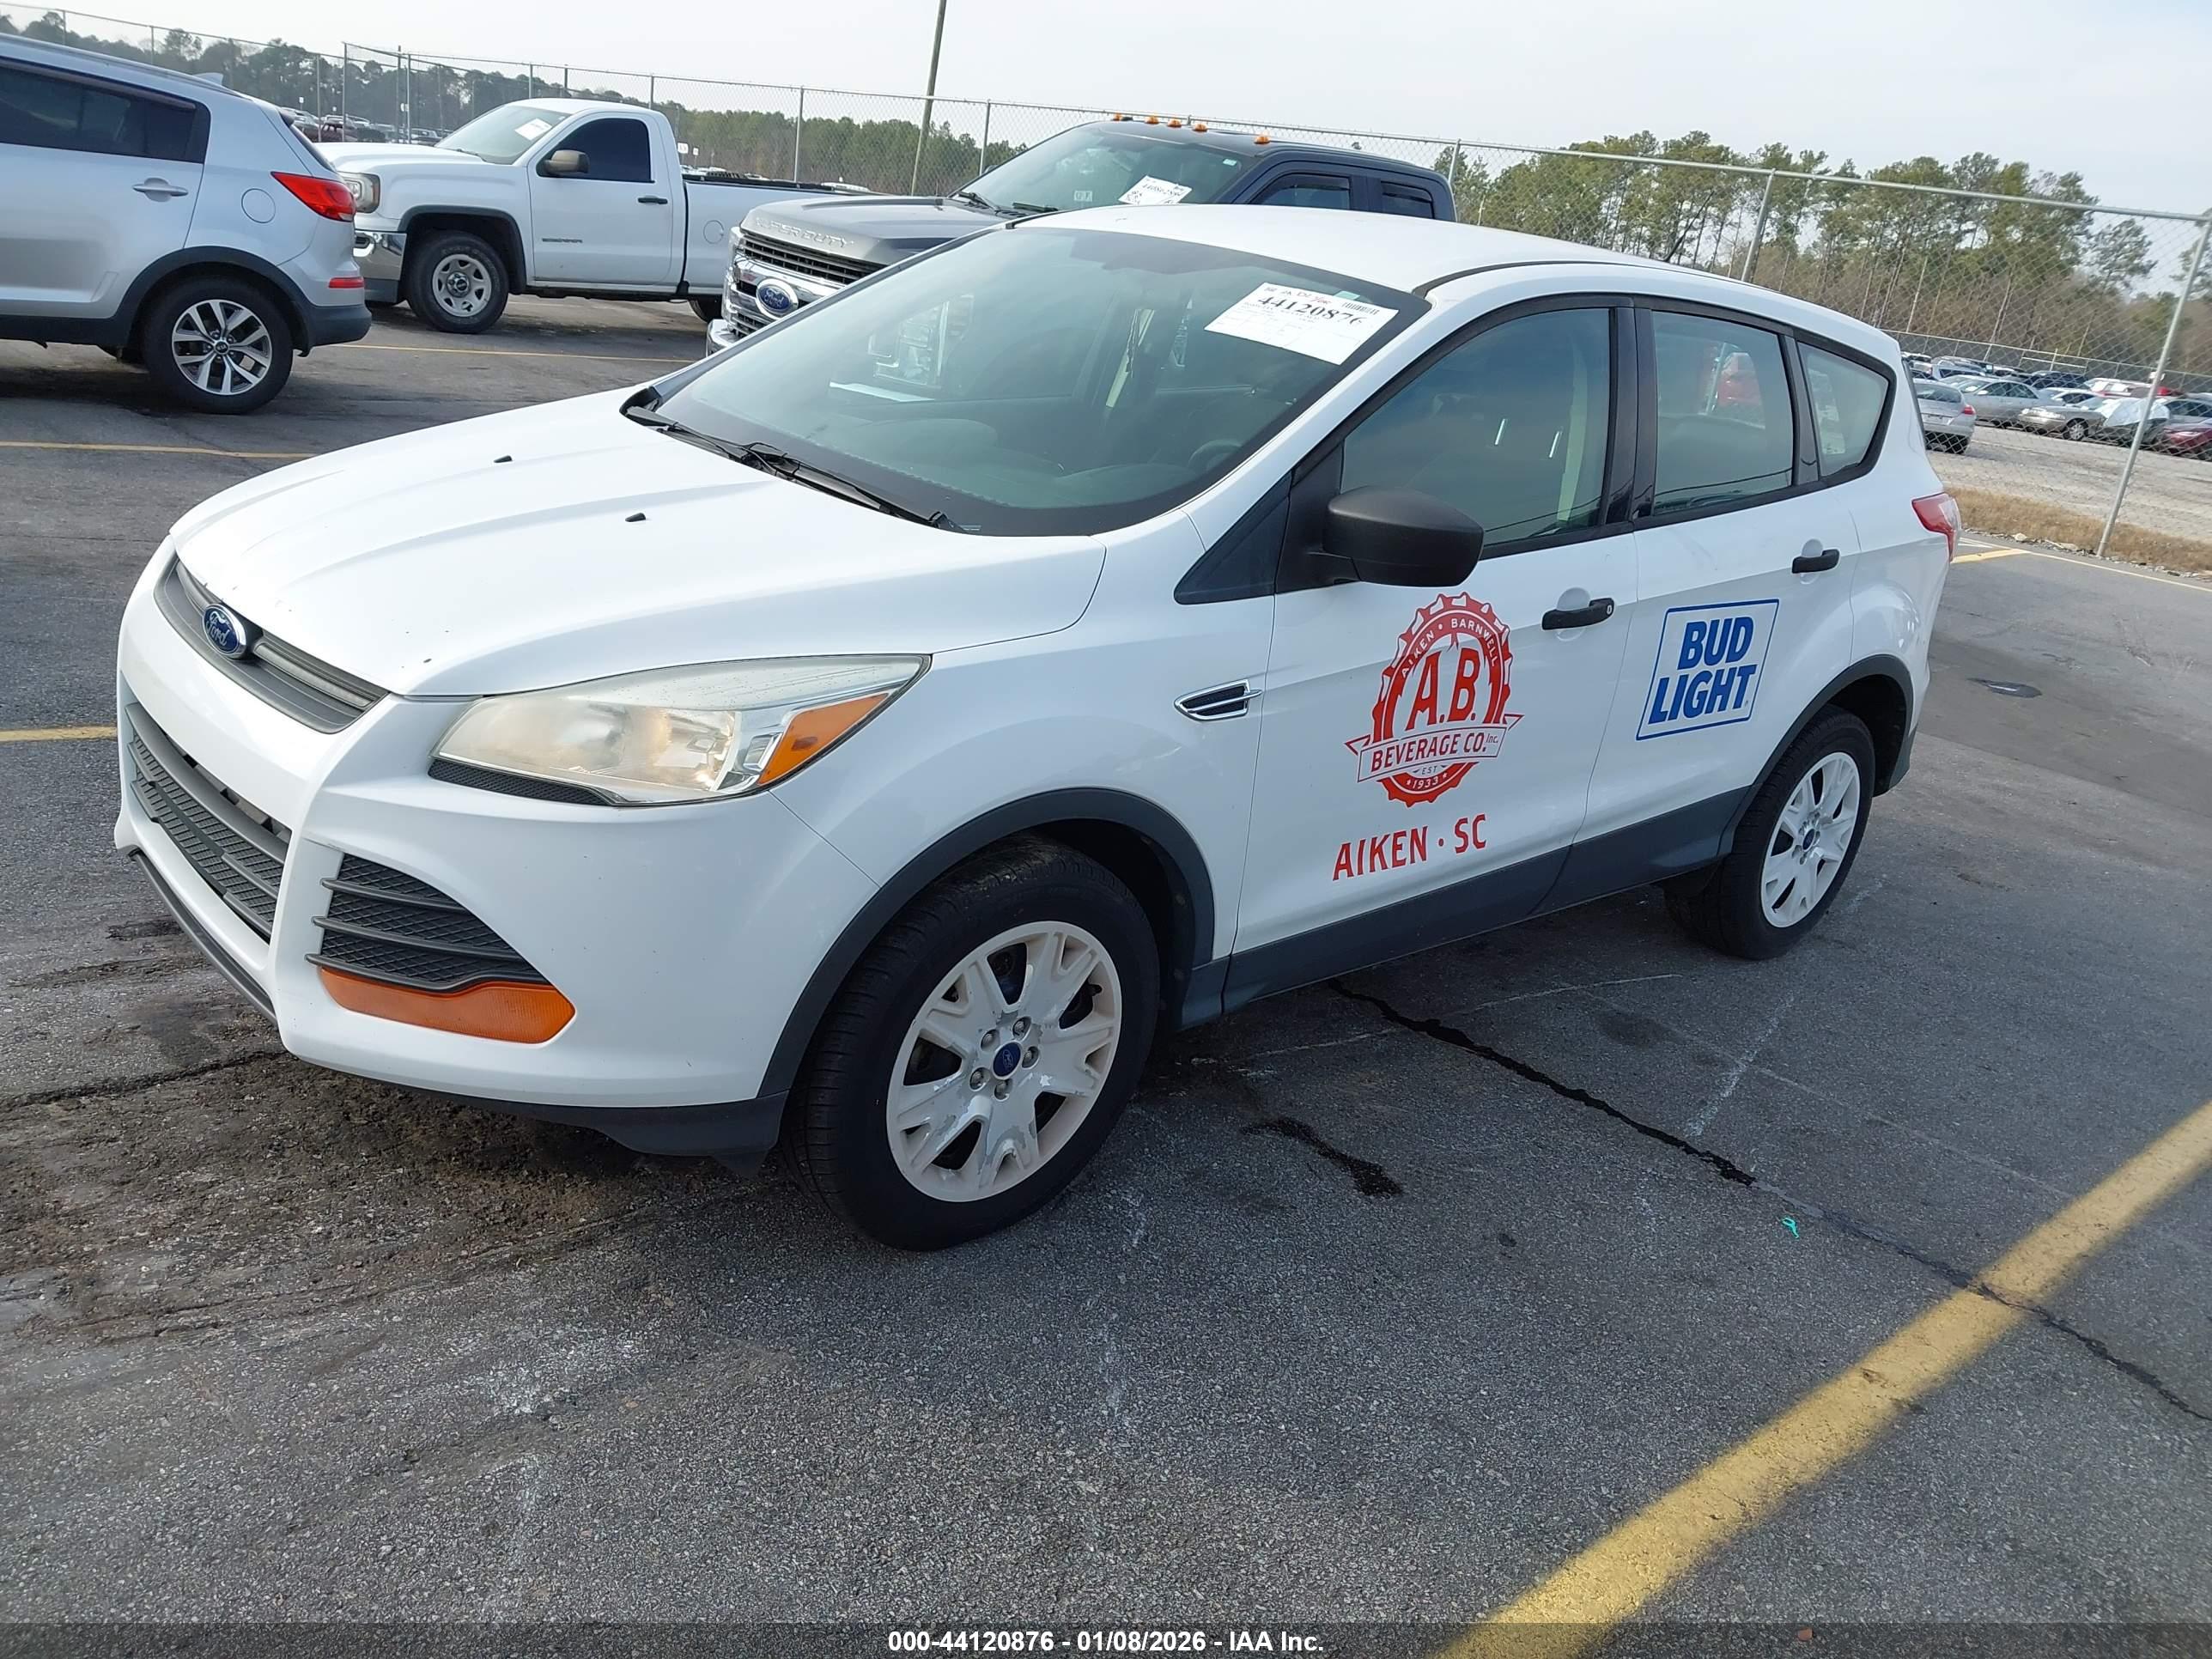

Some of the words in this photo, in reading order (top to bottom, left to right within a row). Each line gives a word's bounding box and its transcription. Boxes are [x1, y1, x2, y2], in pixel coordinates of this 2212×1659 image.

[1258, 296, 1367, 325] 44120876
[206, 611, 233, 647] Ford
[1401, 629, 1435, 678] AIKEN
[1451, 617, 1498, 667] BARNWELL
[1677, 617, 1754, 671] BUD
[1405, 647, 1481, 732] A.B.
[1648, 664, 1758, 725] LIGHT
[1370, 732, 1461, 773] BEVERAGE
[1463, 732, 1487, 753] CO.
[1486, 733, 1499, 744] Inc.
[1421, 764, 1438, 775] EST
[1413, 775, 1440, 790] 1933
[1332, 826, 1428, 881] AIKEN
[1454, 813, 1487, 854] SC
